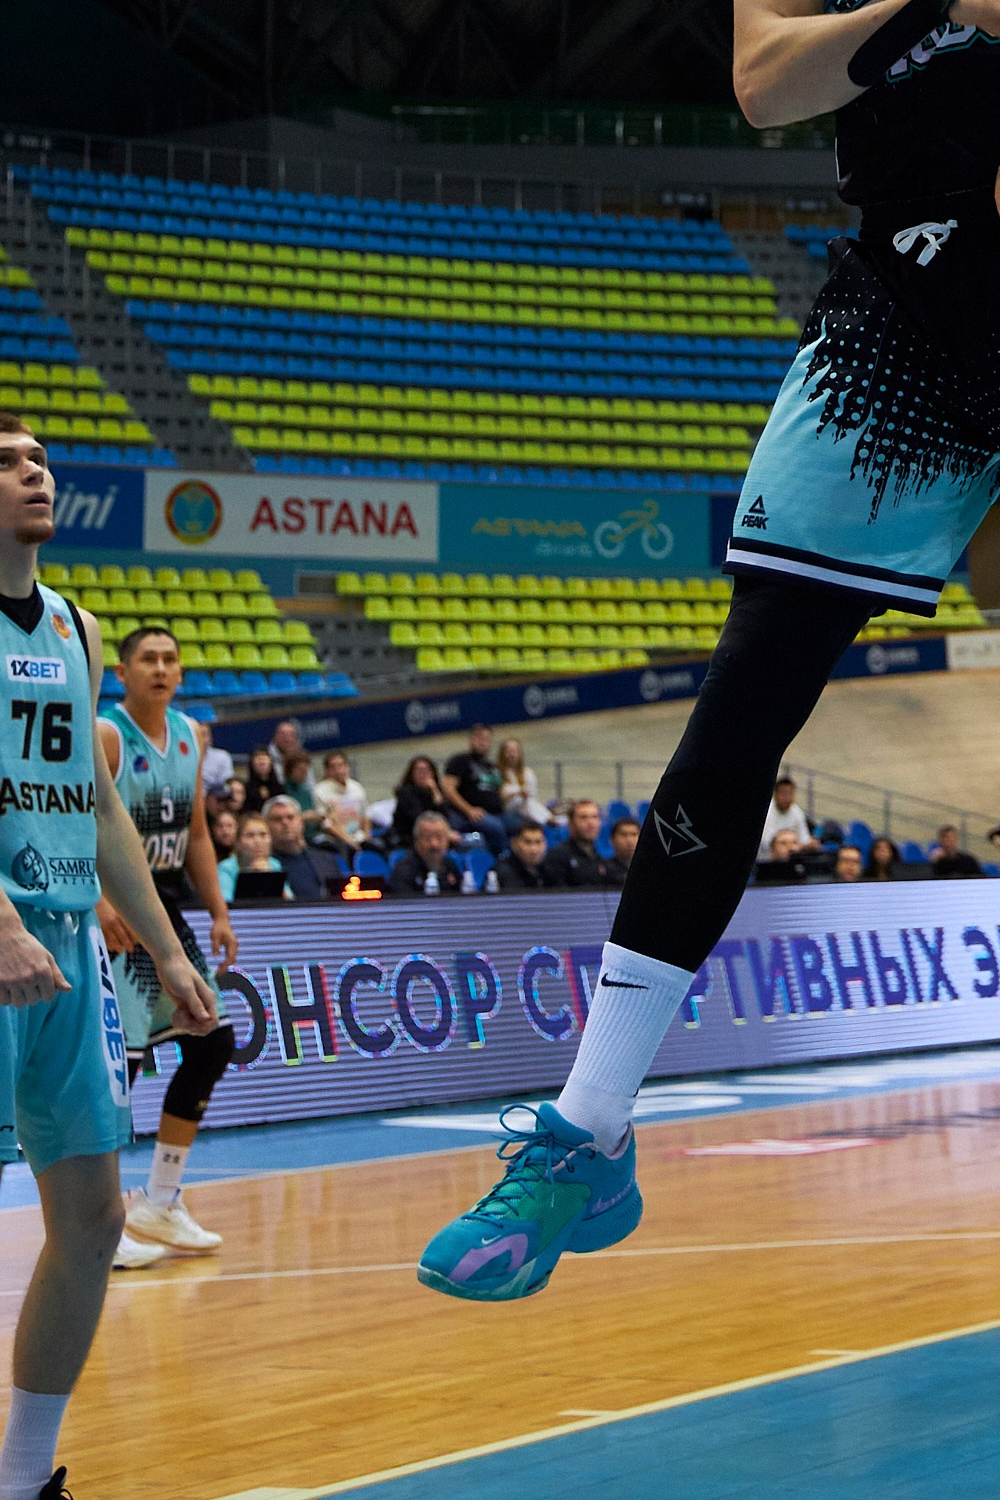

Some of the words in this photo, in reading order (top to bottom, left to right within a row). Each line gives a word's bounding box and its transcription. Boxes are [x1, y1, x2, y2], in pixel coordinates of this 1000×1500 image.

[249, 496, 419, 539] ASTANA
[741, 515, 769, 530] PEAK
[10, 659, 61, 678] 1XBET
[11, 699, 73, 763] 76
[160, 785, 174, 823] 5
[50, 860, 96, 875] SAMRU
